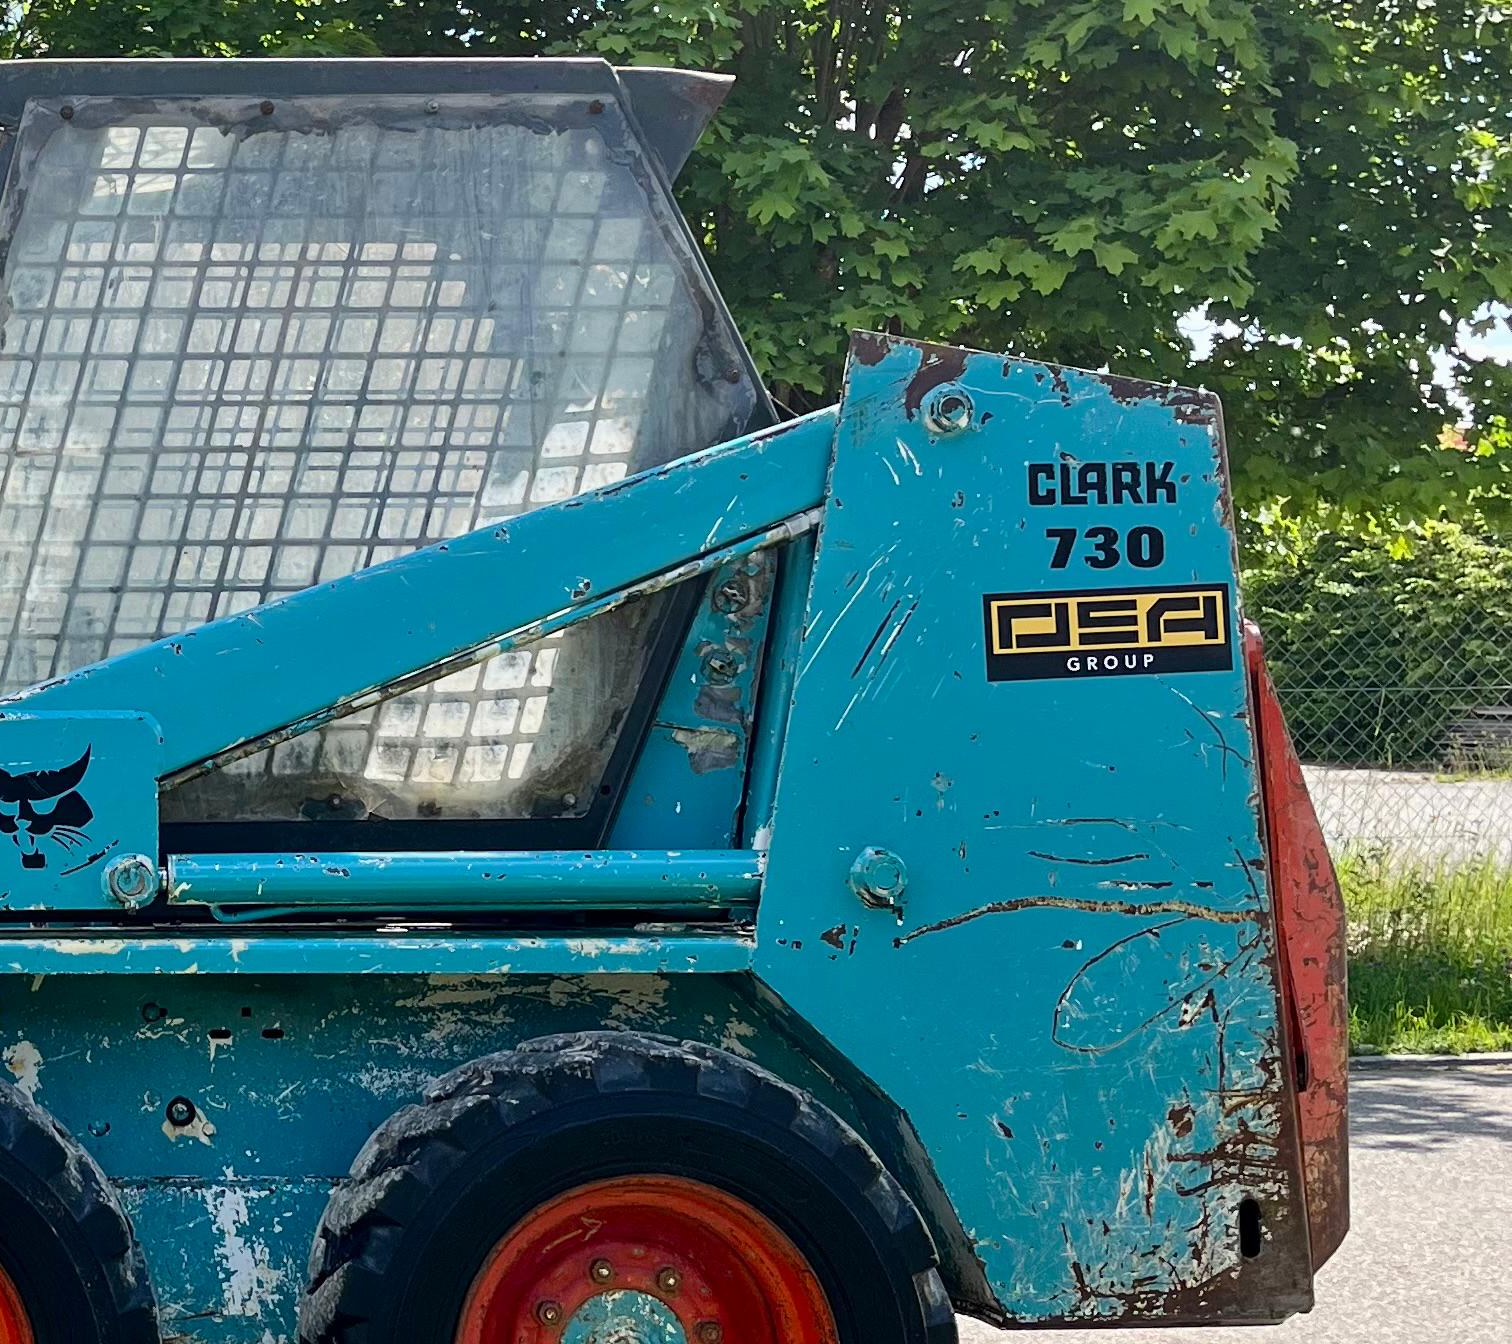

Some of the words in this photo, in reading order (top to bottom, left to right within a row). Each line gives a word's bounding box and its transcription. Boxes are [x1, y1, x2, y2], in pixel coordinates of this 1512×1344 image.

[1028, 461, 1177, 506] CLARK
[1045, 526, 1165, 569] 730
[1066, 653, 1155, 672] GROUP
